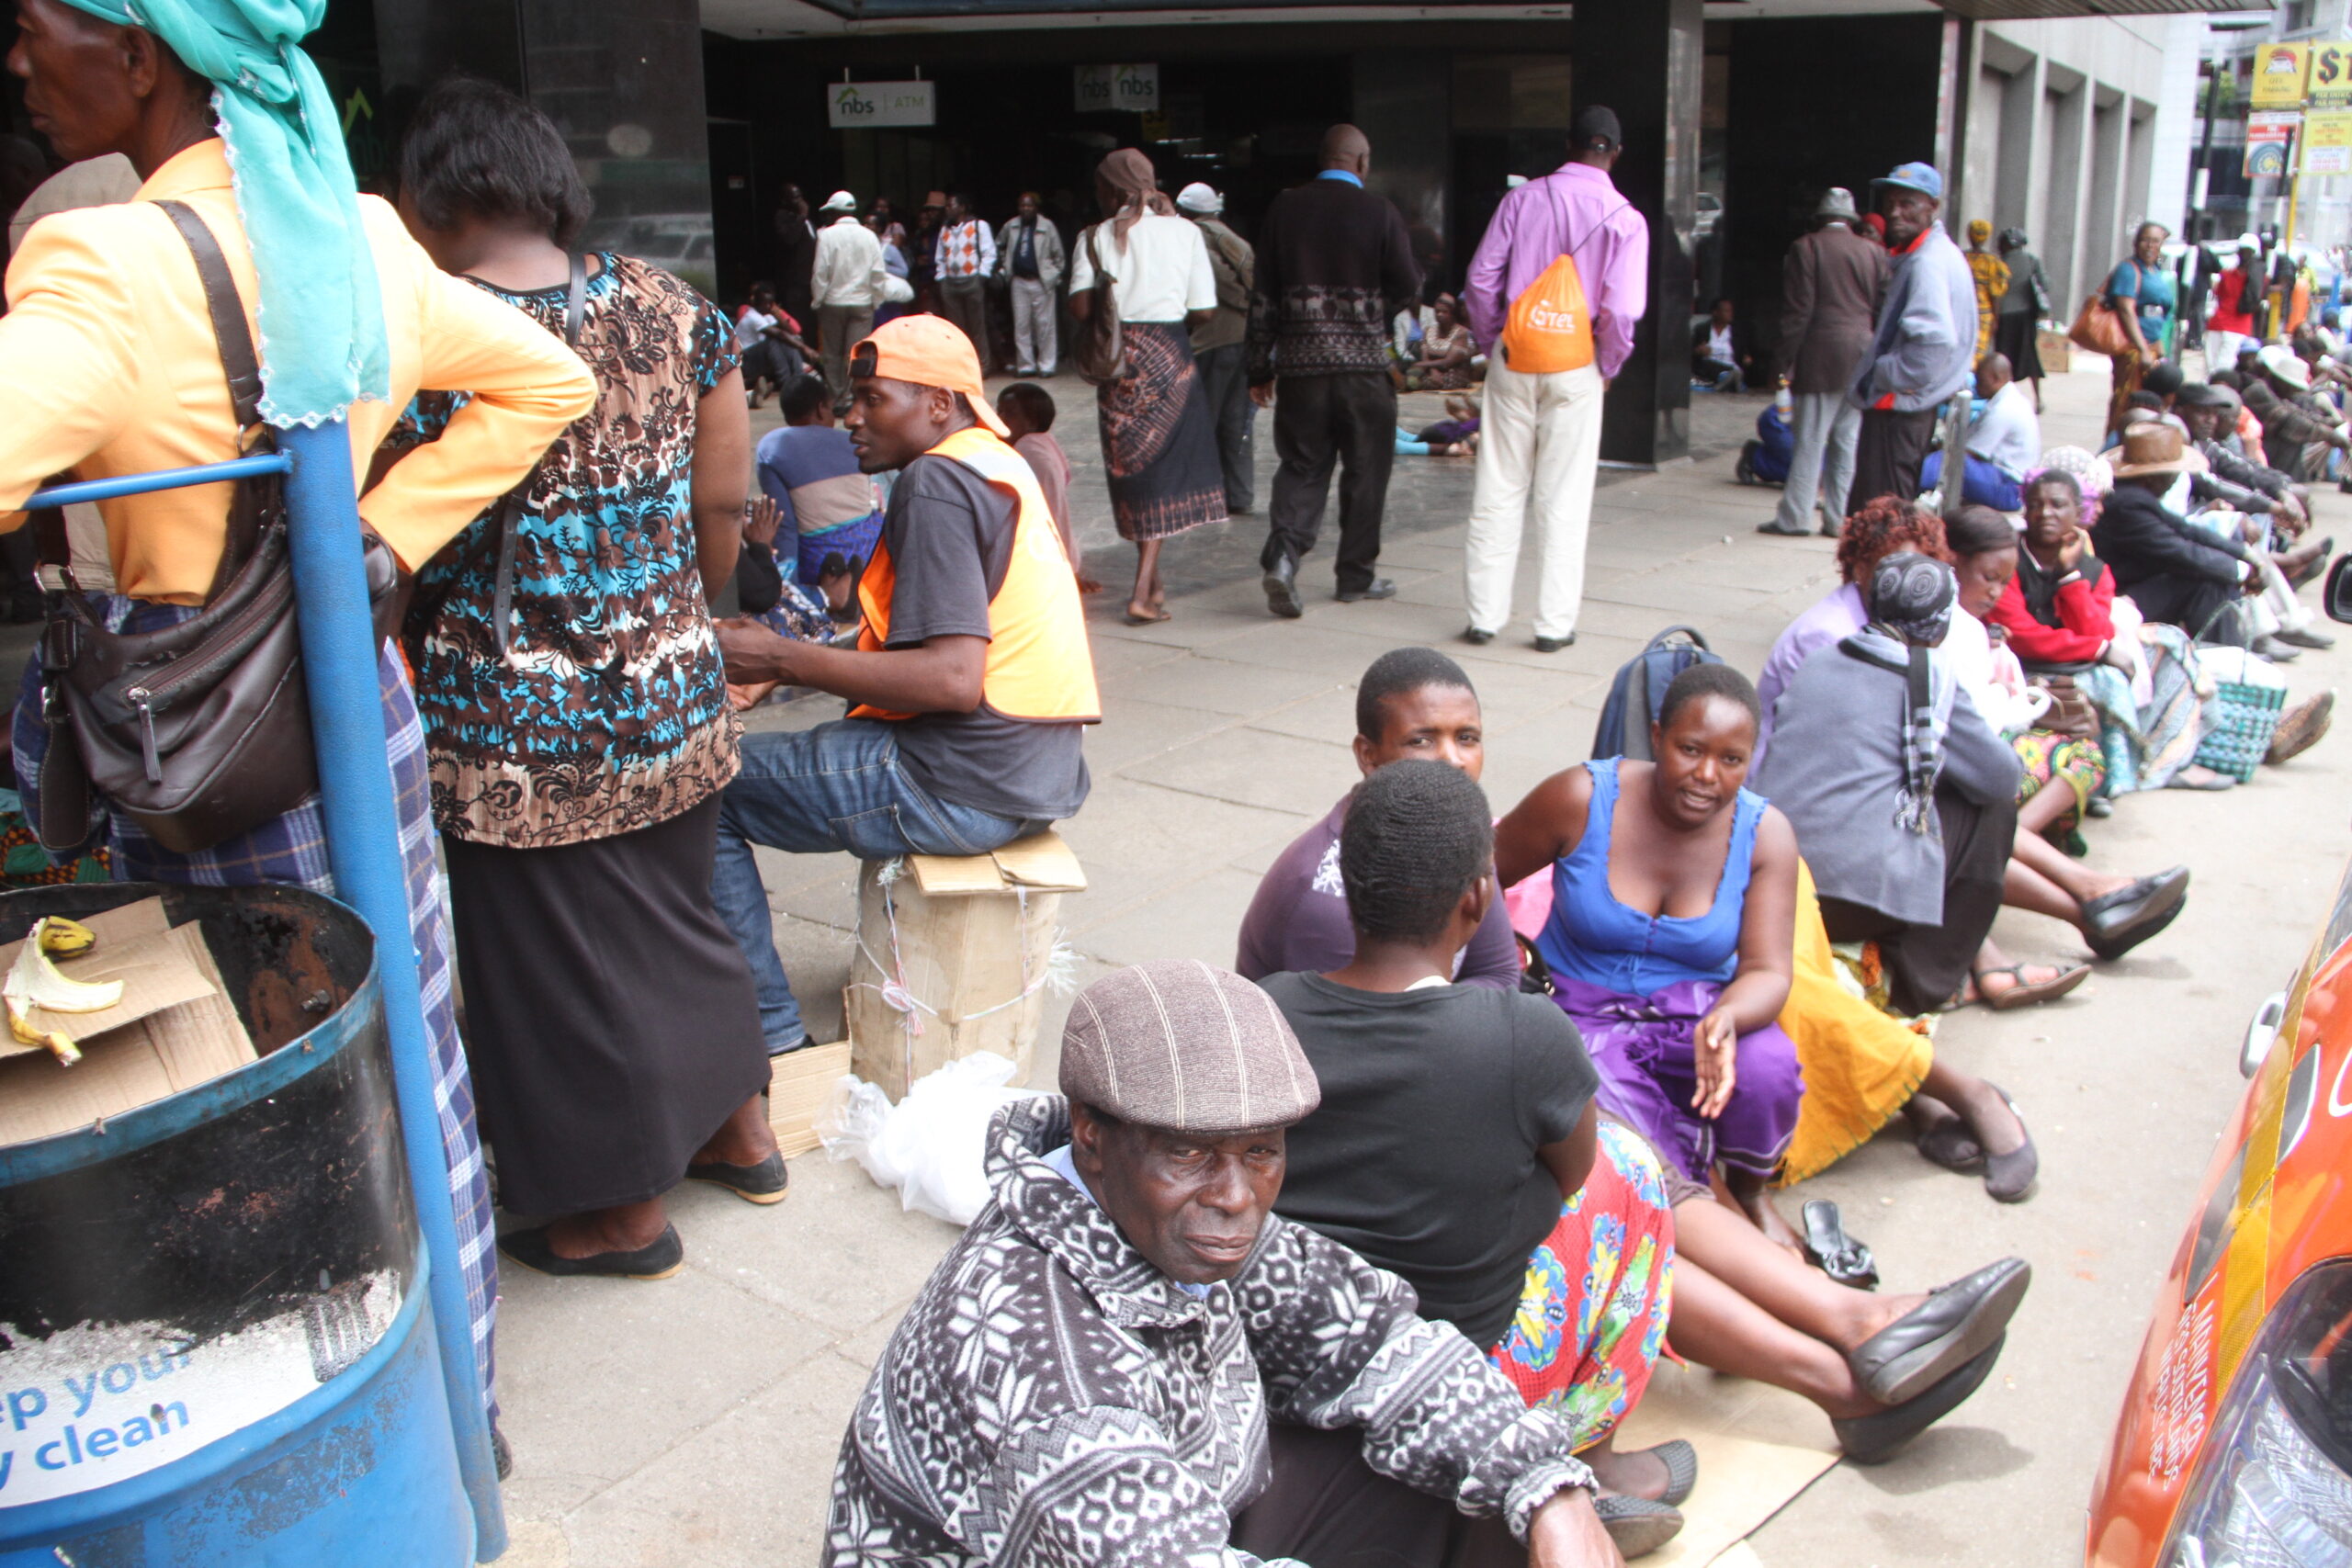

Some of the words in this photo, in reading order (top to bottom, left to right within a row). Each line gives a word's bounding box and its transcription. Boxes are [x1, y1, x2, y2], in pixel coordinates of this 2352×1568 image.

[1119, 73, 1153, 96] nbs
[841, 96, 874, 115] nbs
[895, 96, 925, 108] ATM
[0, 1385, 48, 1432] p
[35, 1399, 190, 1471] clean
